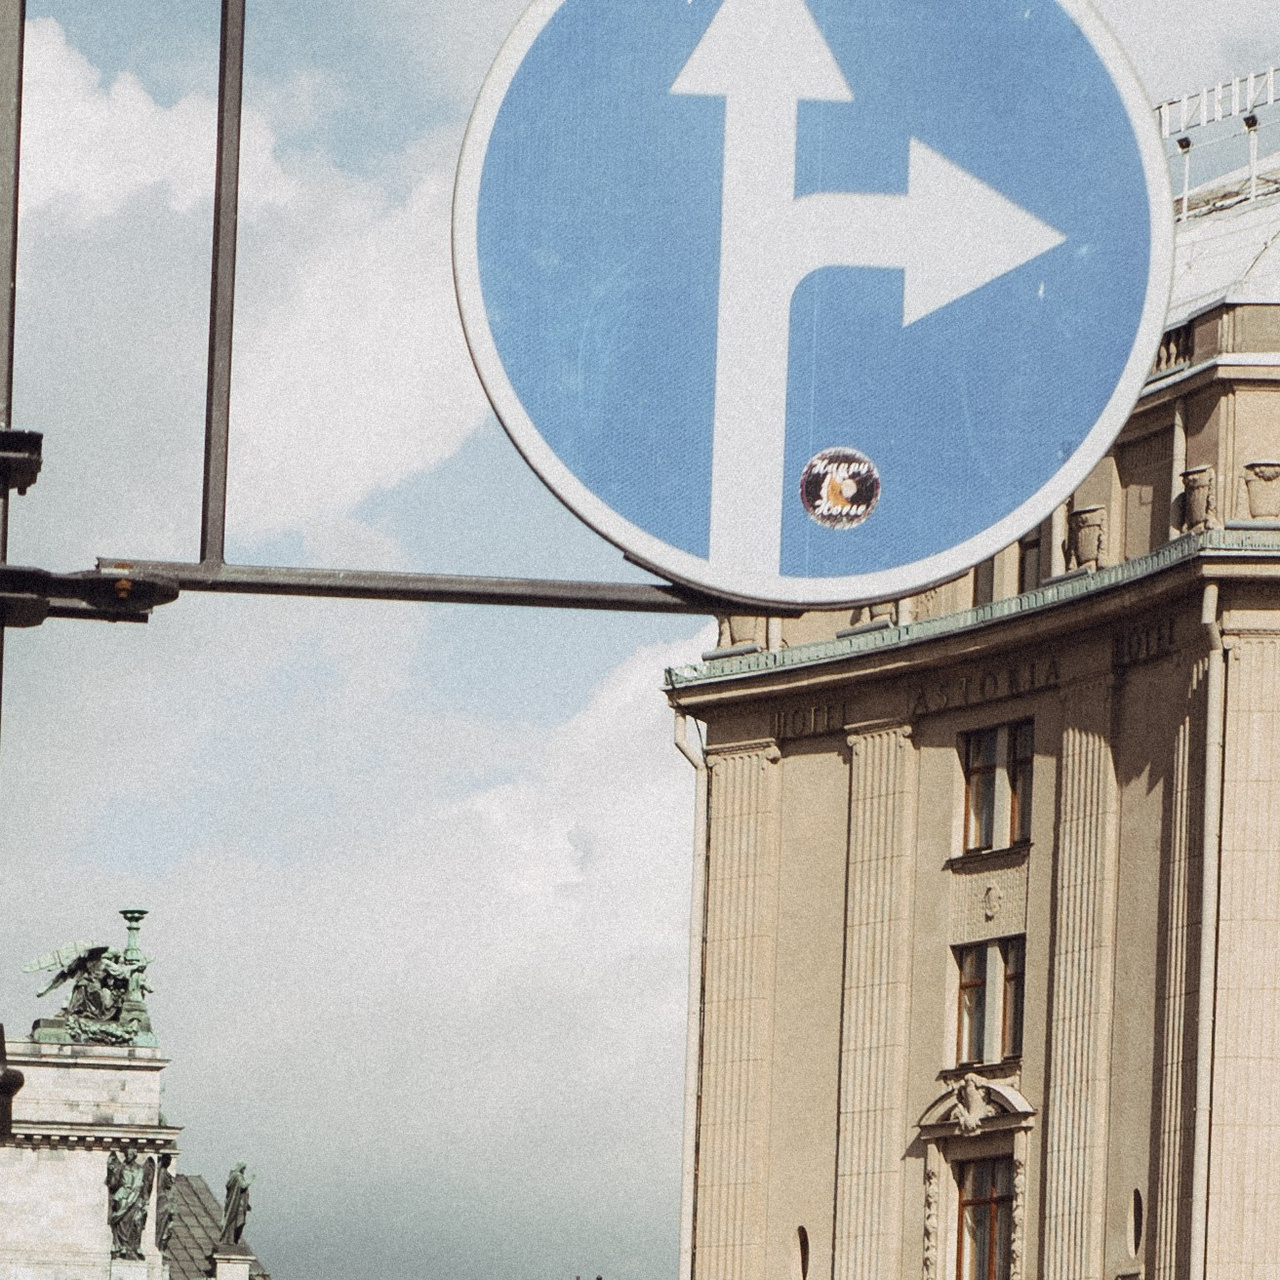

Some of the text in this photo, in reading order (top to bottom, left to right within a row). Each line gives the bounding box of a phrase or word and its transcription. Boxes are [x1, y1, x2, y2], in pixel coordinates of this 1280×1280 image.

[811, 459, 869, 483] Happy
[814, 499, 867, 516] Horse
[912, 656, 1060, 715] ASTORIA
